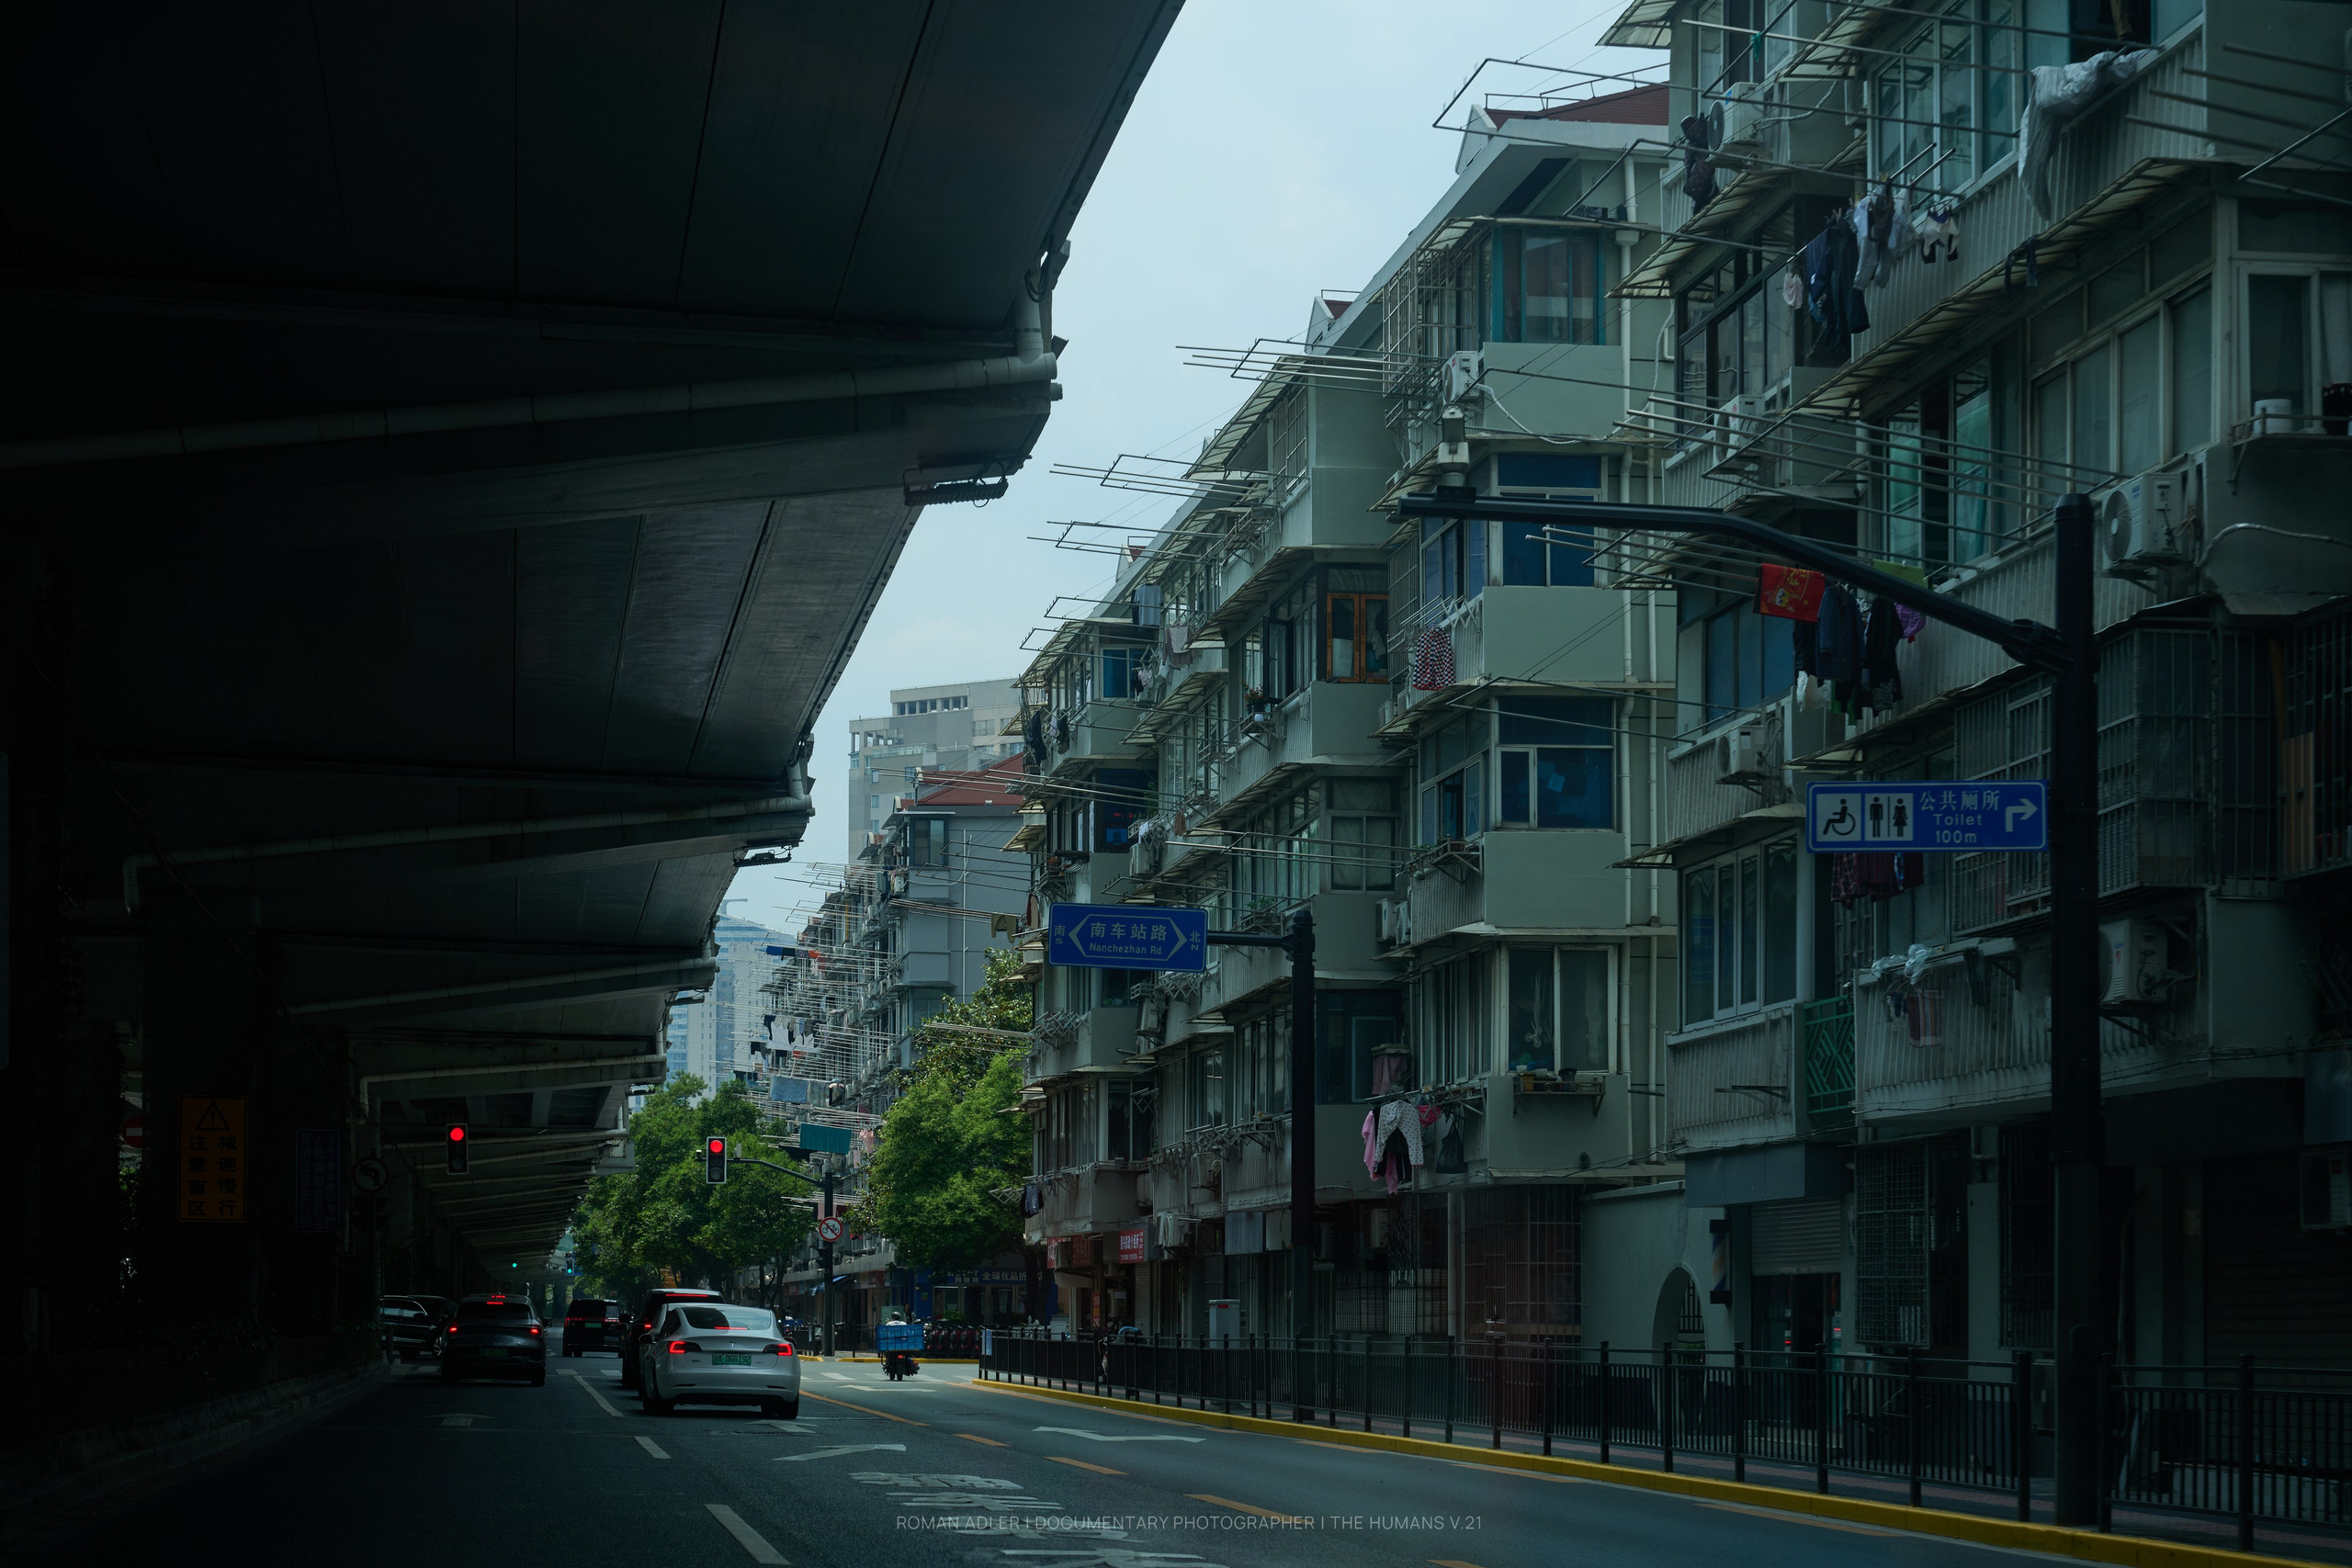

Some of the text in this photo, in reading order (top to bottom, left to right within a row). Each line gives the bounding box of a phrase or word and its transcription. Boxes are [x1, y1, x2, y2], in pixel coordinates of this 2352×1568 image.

[1918, 790, 2000, 811] 公共厕所
[1932, 813, 1984, 826] Toilet
[1936, 829, 1977, 844] 100m
[1054, 924, 1066, 937] 南
[1090, 921, 1168, 942] 南车站路
[1189, 931, 1201, 943] 北
[1090, 942, 1147, 954] Nanchezhan
[187, 1134, 208, 1216] 注意盲区
[217, 1134, 238, 1216] 减速慢行
